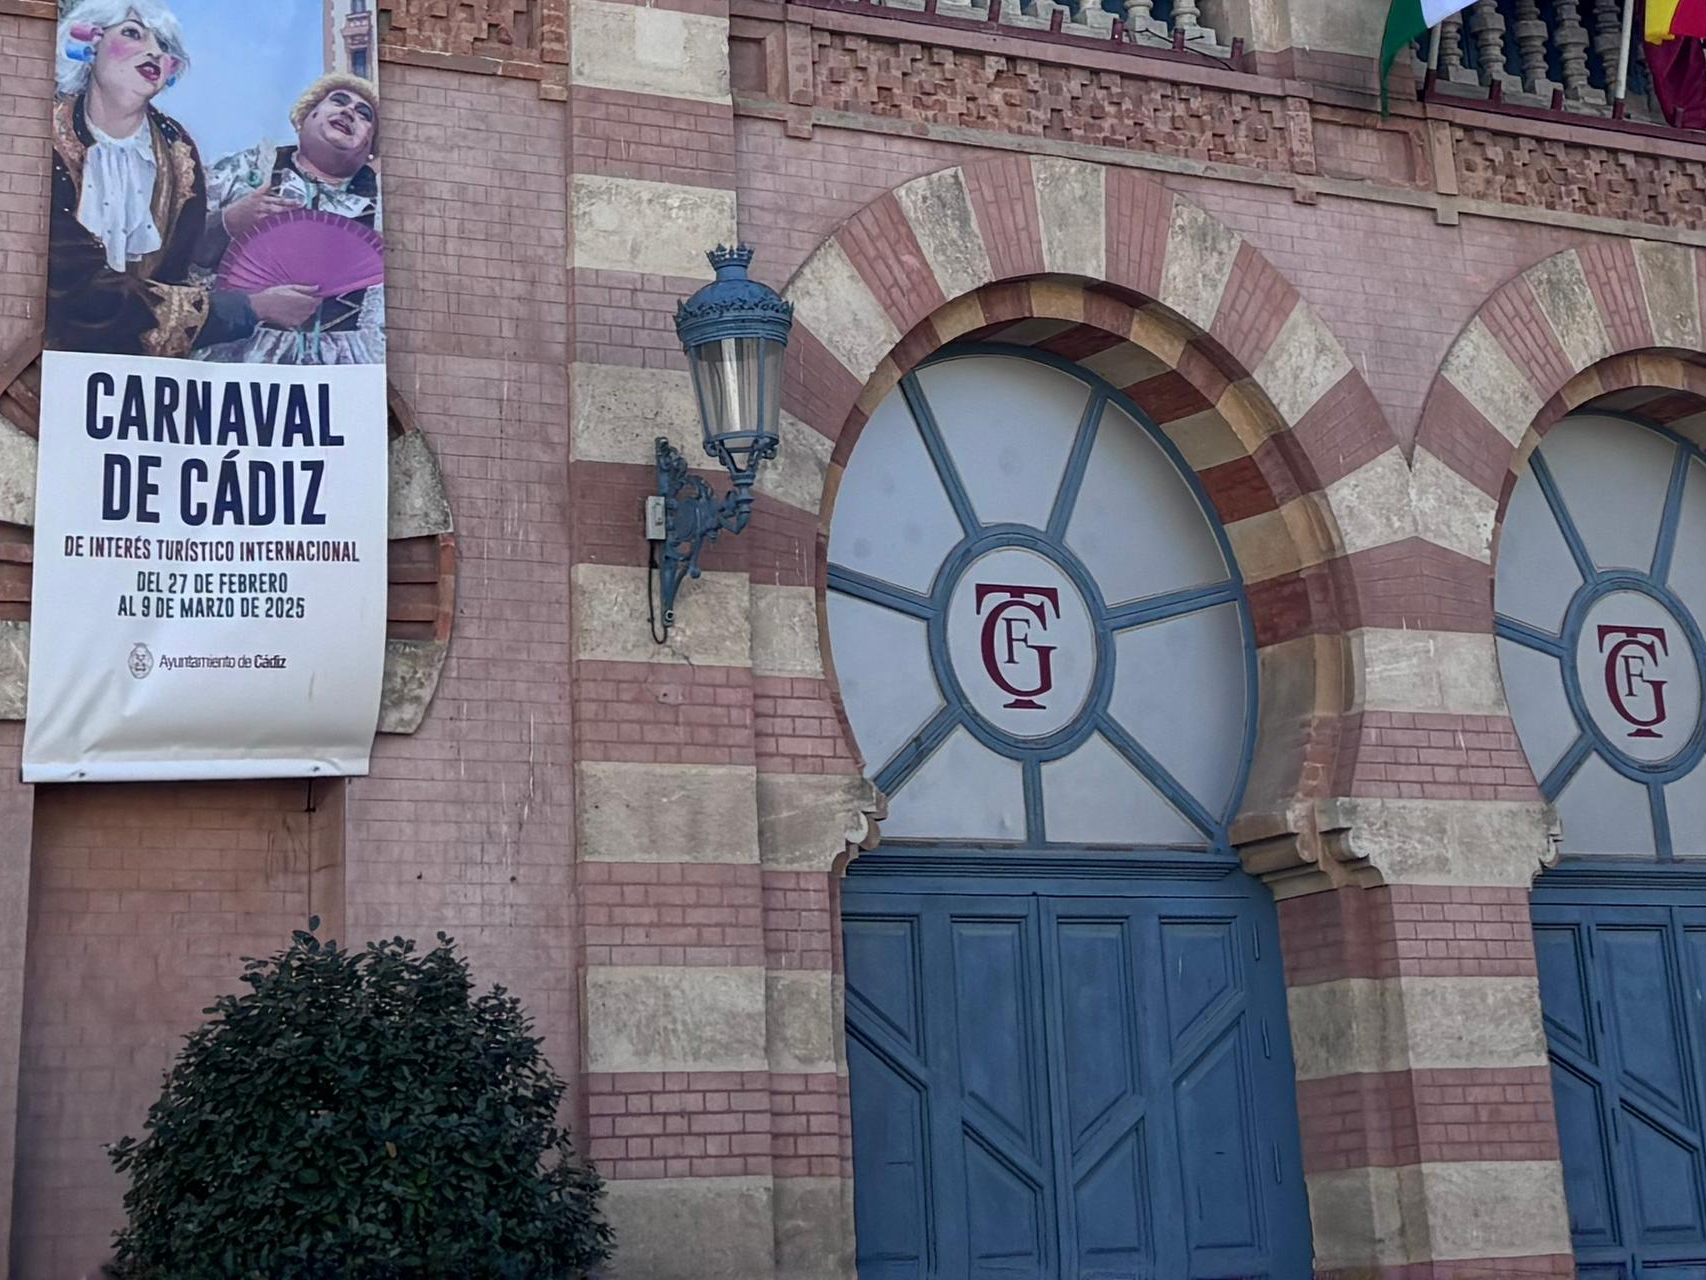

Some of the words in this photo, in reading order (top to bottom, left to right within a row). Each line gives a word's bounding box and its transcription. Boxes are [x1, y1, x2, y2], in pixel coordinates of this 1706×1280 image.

[86, 372, 344, 447] CARNAVAL
[102, 454, 161, 523] DE
[181, 449, 326, 526] CÁDIZ
[65, 536, 84, 556] DE
[90, 536, 150, 559] INTERÉS
[157, 538, 234, 562] TURÍSTICO
[240, 541, 359, 562] INTERNACIONAL
[137, 571, 162, 592] DEL
[169, 573, 187, 594] 27
[195, 573, 213, 593] DE
[219, 572, 287, 593] FEBRERO
[118, 596, 135, 616] AL
[143, 596, 150, 617] 9
[156, 598, 174, 618] DE
[180, 597, 233, 618] MARZO
[241, 597, 259, 618] DE
[265, 598, 305, 618] 2025
[159, 654, 235, 670] Ayuntamiento
[238, 655, 251, 668] de
[255, 654, 286, 668] Cádiz
